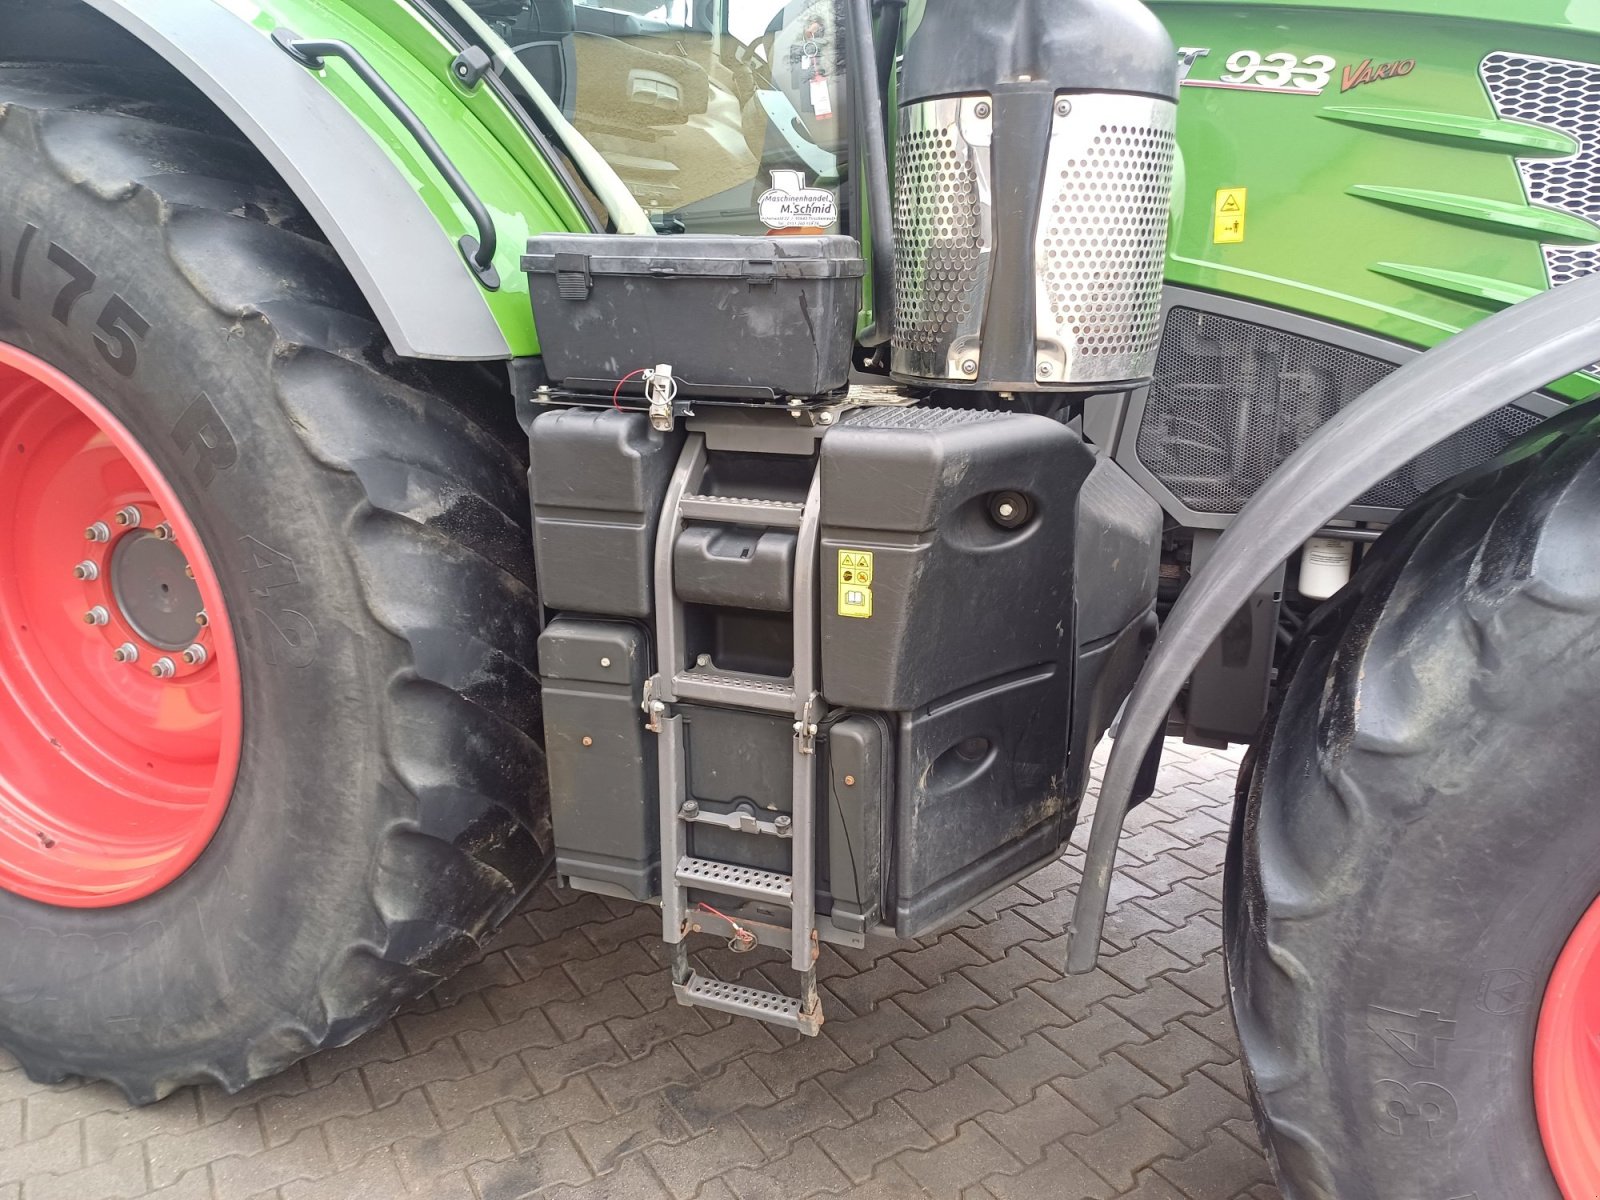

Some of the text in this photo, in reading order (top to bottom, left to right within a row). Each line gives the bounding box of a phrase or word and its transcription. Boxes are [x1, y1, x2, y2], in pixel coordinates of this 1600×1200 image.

[1220, 50, 1336, 90] 933
[1340, 58, 1416, 94] VARIO
[764, 194, 829, 202] Maschinenhandel
[780, 203, 832, 213] M.Schmid
